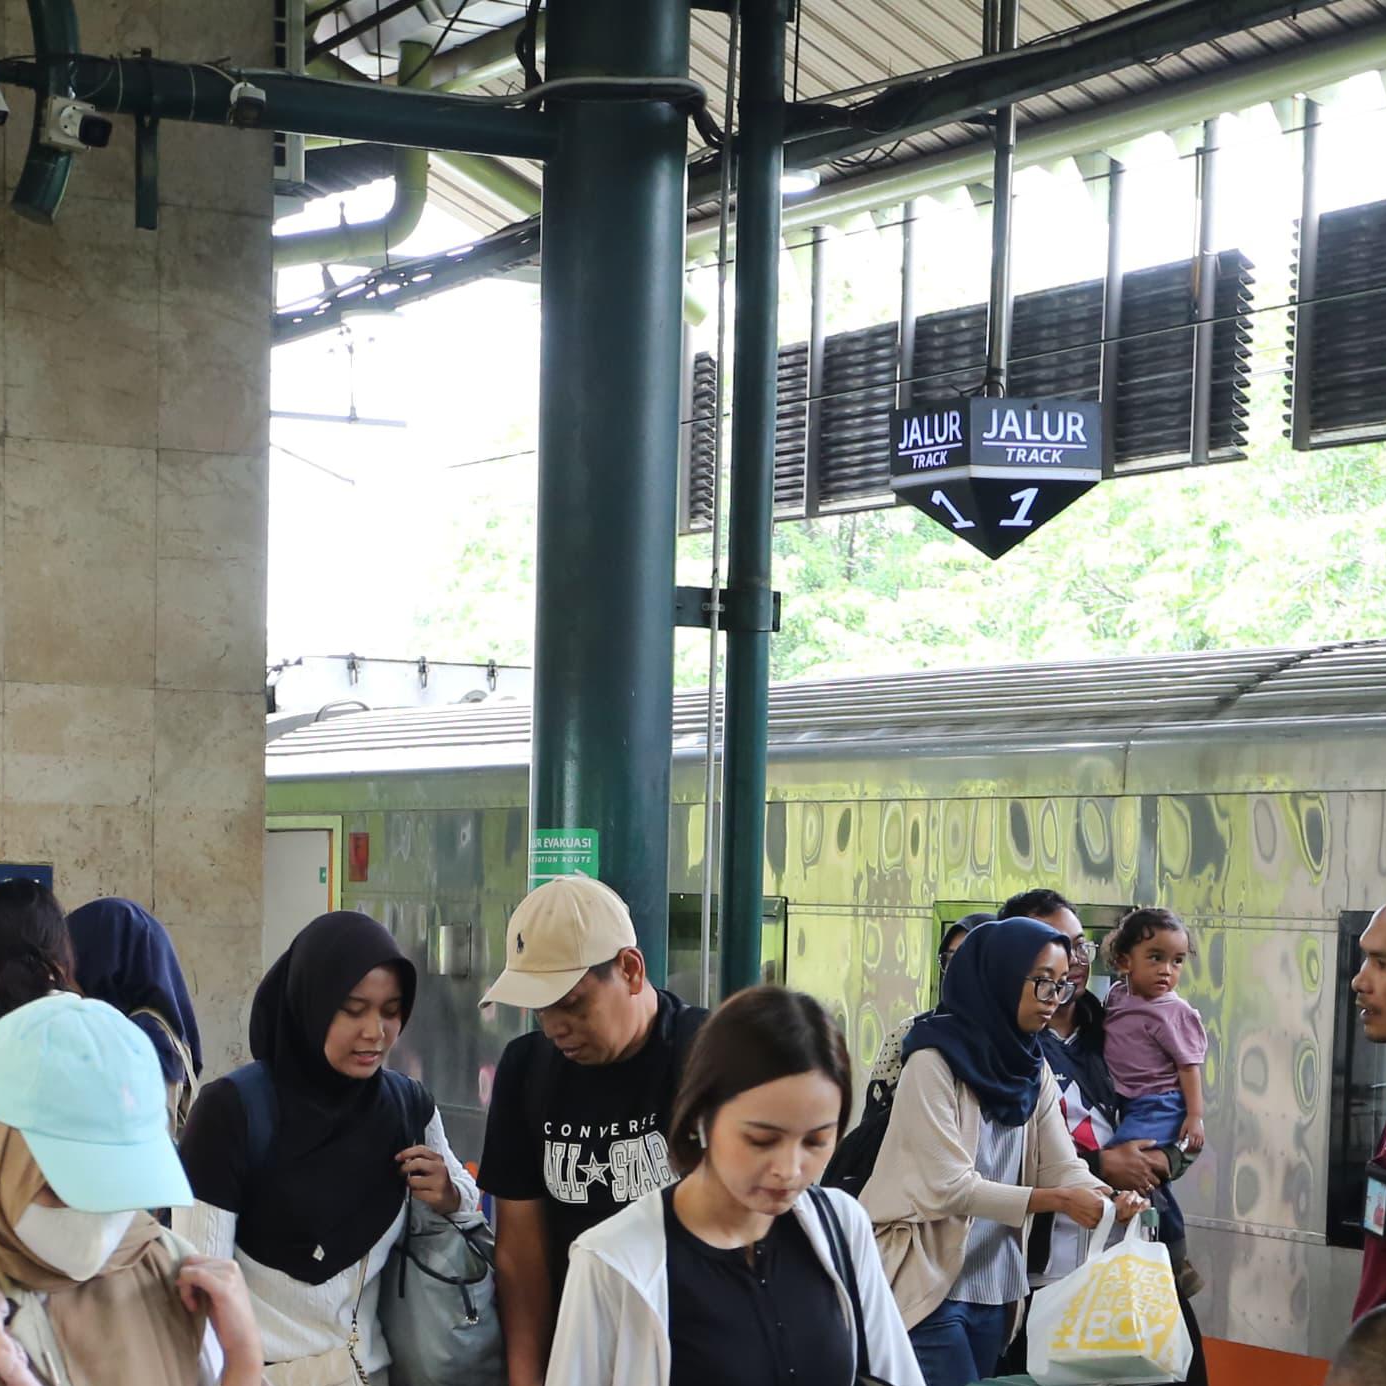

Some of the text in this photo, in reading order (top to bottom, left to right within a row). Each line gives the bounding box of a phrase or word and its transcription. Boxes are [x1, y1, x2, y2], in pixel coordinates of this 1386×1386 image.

[897, 410, 963, 450] JALUR
[982, 408, 1087, 443] JALUR
[912, 450, 948, 469] TRACK
[1005, 448, 1063, 464] TRACK
[931, 490, 975, 529] 1
[999, 487, 1038, 527] 1
[543, 837, 591, 849] EVAKUASI
[562, 856, 591, 864] ROUTE
